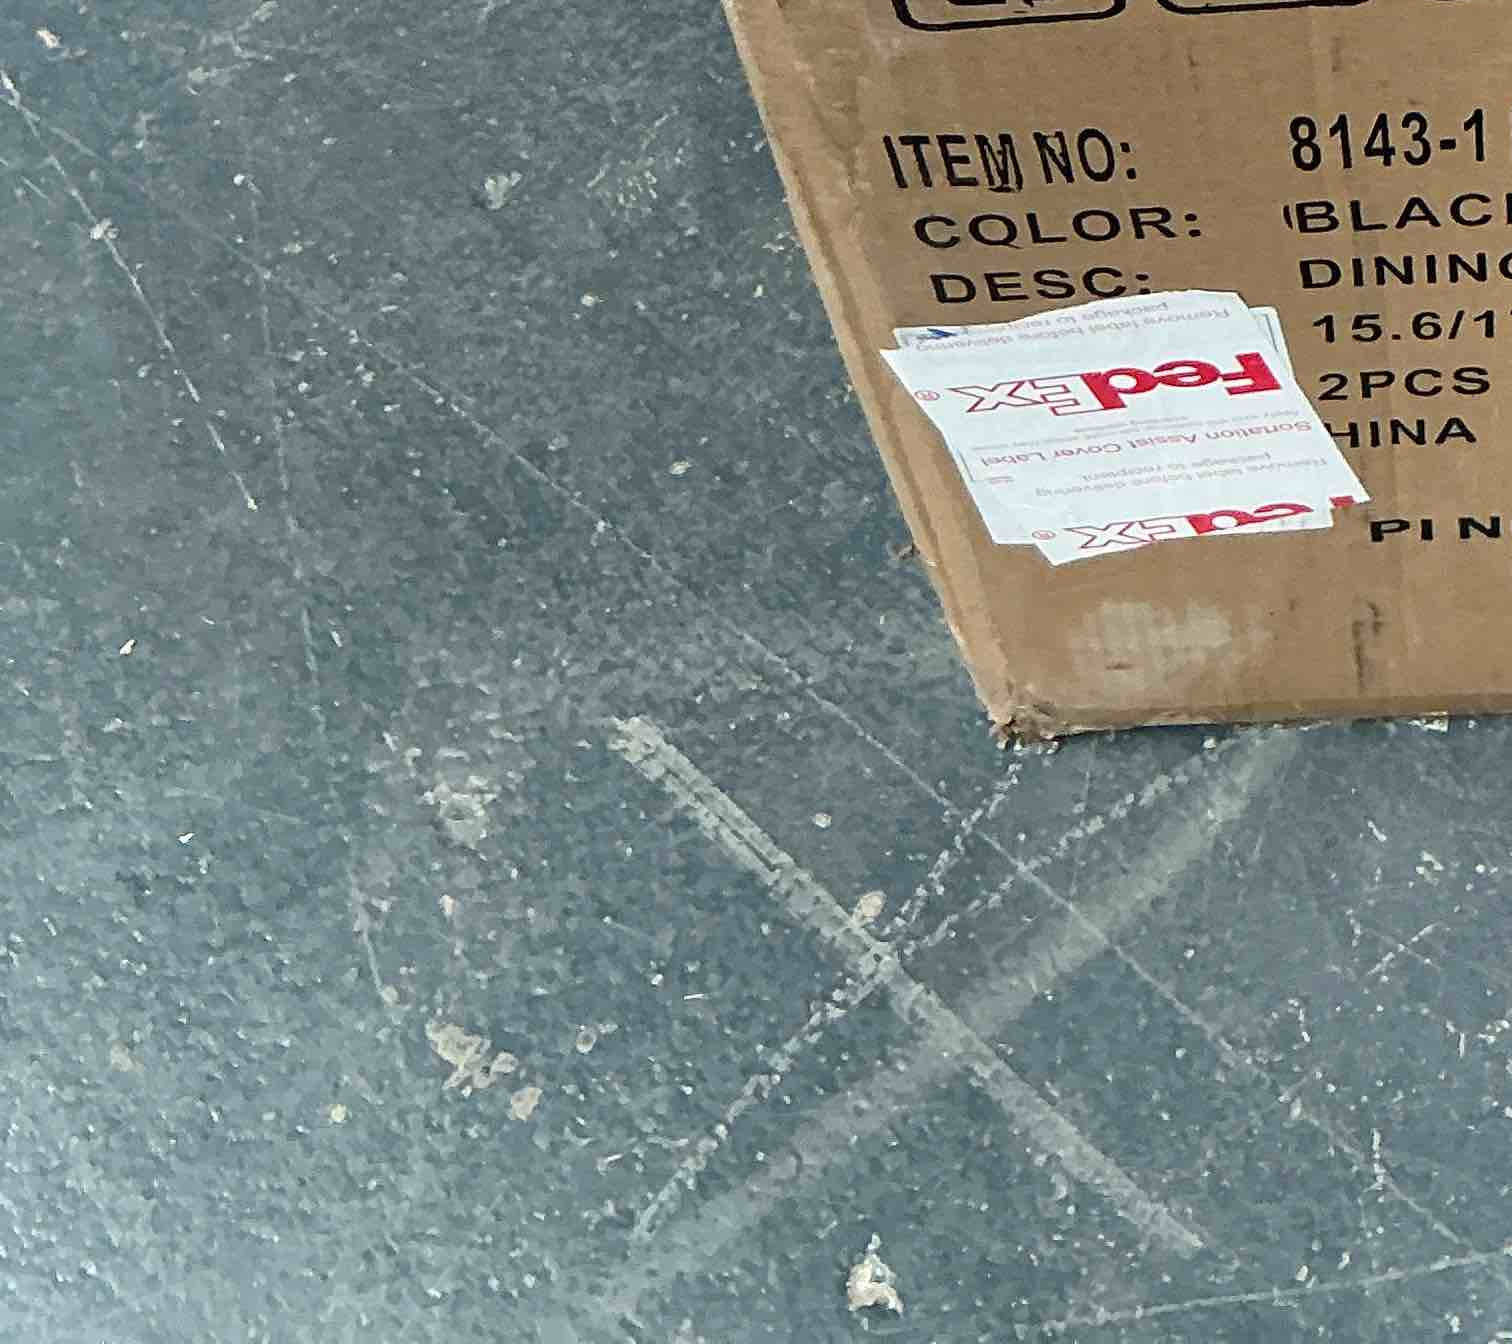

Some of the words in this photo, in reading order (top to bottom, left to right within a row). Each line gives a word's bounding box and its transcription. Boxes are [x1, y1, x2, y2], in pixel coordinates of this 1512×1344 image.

[882, 133, 1024, 194] ITEM
[1032, 128, 1137, 185] NO:
[1288, 112, 1486, 172] 8143-1
[929, 266, 1151, 304] DESC:
[950, 351, 1281, 417] FedEx
[1317, 366, 1491, 402] 2PCS
[1128, 434, 1199, 449] Assist
[1323, 417, 1477, 449] HINA
[981, 452, 1046, 467] Label
[1053, 444, 1121, 458] Cover
[1369, 518, 1434, 544] PI
